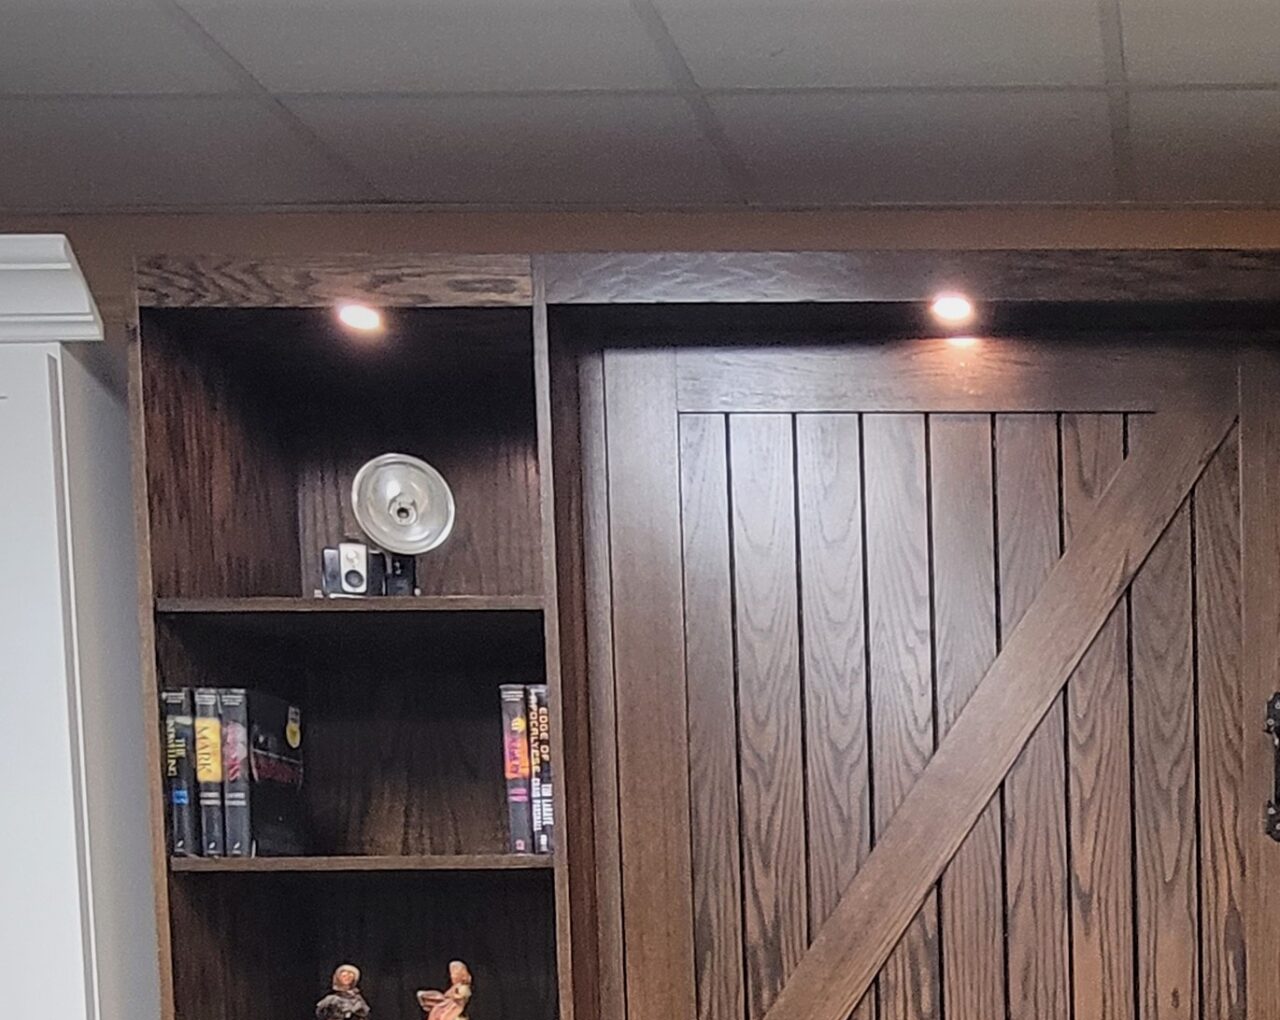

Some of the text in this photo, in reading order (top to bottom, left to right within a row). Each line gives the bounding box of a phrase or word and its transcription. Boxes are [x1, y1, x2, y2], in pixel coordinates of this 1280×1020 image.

[197, 726, 212, 774] MARK
[539, 707, 549, 761] EDGE OF
